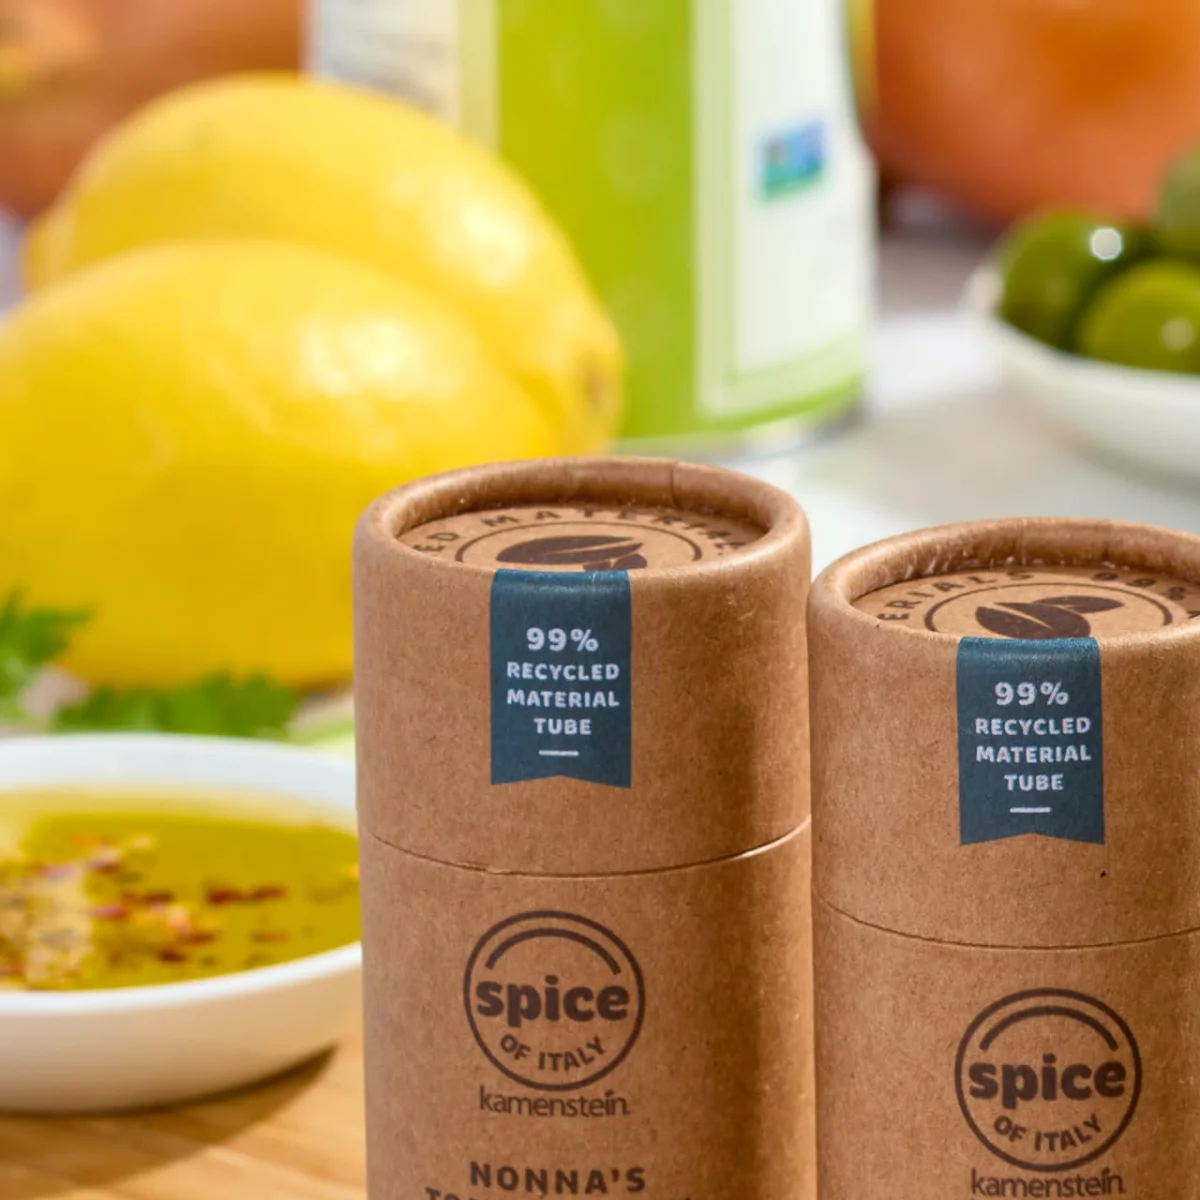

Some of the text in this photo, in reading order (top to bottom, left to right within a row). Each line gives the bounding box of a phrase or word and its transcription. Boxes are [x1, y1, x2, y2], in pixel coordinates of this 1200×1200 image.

[877, 570, 1034, 621] ERIALS
[526, 627, 599, 652] 99%
[506, 661, 620, 681] RECYCLED
[506, 688, 620, 709] MATERIAL
[994, 681, 1069, 706] 99%
[533, 717, 592, 736] TUBE
[974, 716, 1092, 736] RECYCLED
[975, 744, 1092, 764] MATERIAL
[1004, 773, 1064, 792] TUBE
[475, 974, 630, 1028] spice
[499, 1033, 607, 1073] OF ITALY
[968, 1052, 1127, 1110] spice
[478, 1084, 629, 1119] kamenstein
[993, 1113, 1102, 1152] OF ITALY
[469, 1160, 646, 1195] NONNA'S
[970, 1167, 1125, 1199] kamenstein
